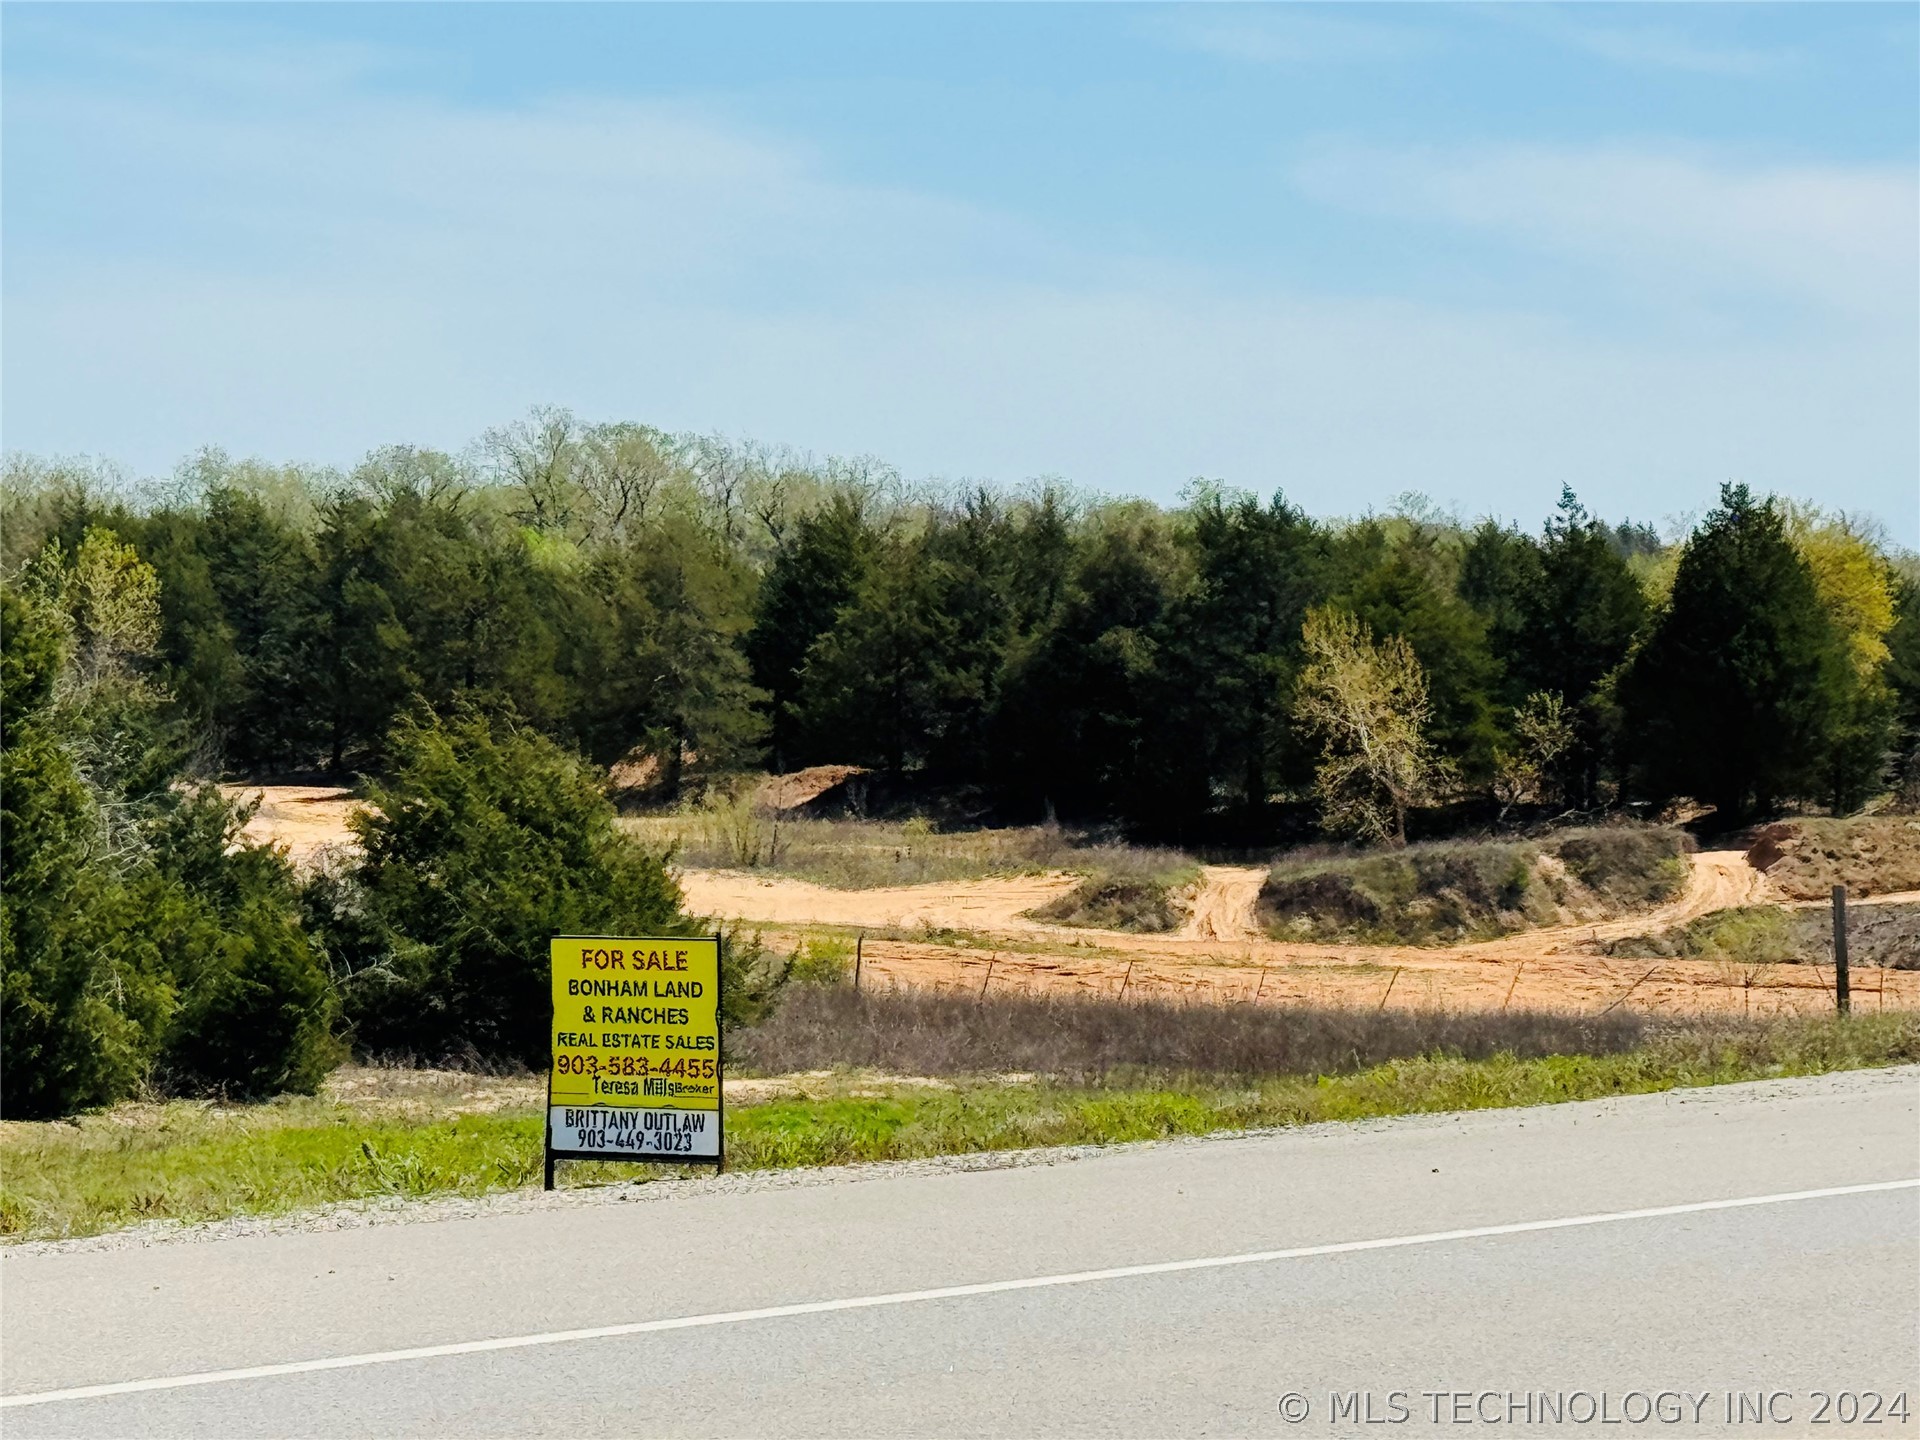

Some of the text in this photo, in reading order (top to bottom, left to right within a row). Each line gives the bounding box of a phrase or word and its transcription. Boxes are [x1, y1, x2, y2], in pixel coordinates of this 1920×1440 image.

[582, 949, 688, 971] FOR SALE
[568, 979, 703, 998] BONHAM LAND
[583, 1006, 689, 1025] & RANCHES
[557, 1032, 715, 1050] REAL ESTATE SALES
[557, 1054, 715, 1079] 903-583-4455
[592, 1075, 639, 1095] Teresa
[565, 1109, 705, 1132] BRITTANY OUTLAW
[578, 1129, 692, 1151] 903-449-3023
